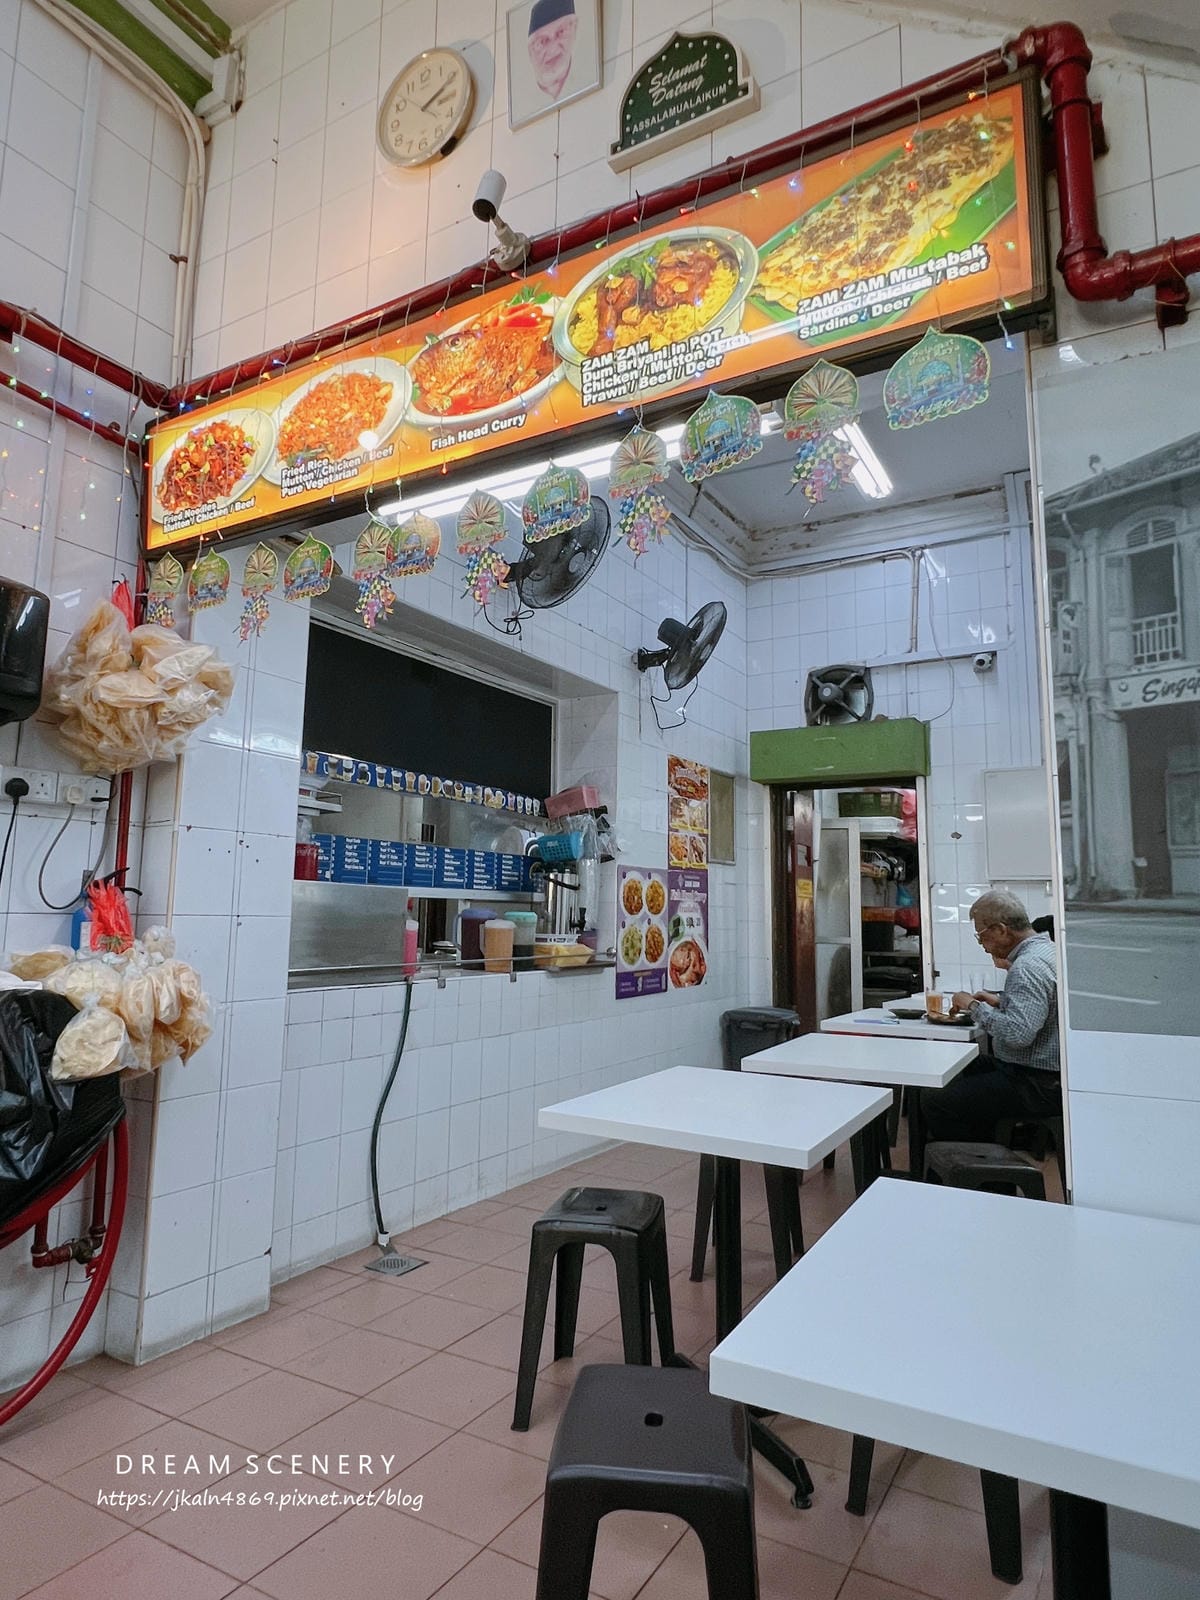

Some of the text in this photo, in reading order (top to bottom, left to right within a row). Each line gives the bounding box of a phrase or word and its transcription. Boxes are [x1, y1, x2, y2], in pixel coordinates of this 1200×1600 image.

[406, 80, 415, 95] 11
[648, 53, 708, 94] Selamat
[395, 97, 408, 113] 10
[651, 74, 705, 107] Datang
[632, 83, 728, 134] ASSALAMUALAIKUM
[390, 119, 401, 133] 9
[394, 134, 404, 148] 8
[798, 243, 989, 314] ZAM ZAM Murtabak
[945, 257, 990, 281] Beef
[798, 313, 860, 340] Sardine
[870, 296, 912, 318] Deer
[582, 366, 614, 384] Dum
[616, 349, 671, 374] Briyani
[672, 341, 688, 357] In
[690, 327, 723, 350] POT
[582, 339, 651, 373] ZAM ZAM
[582, 370, 639, 394] Chicken
[649, 351, 704, 376] Mutton
[582, 386, 628, 407] Prawn
[638, 370, 673, 390] Beef
[685, 355, 723, 377] Deer
[430, 413, 528, 451] Fish Head Curry
[281, 472, 315, 488] Mutton
[321, 457, 361, 477] Chicken
[368, 444, 395, 461] Beef
[281, 457, 330, 479] Fried Rice
[281, 468, 359, 498] Pure Vegetarian
[163, 502, 217, 526] Fried Noodles
[196, 507, 229, 525] Chicken
[235, 496, 256, 511] Beef
